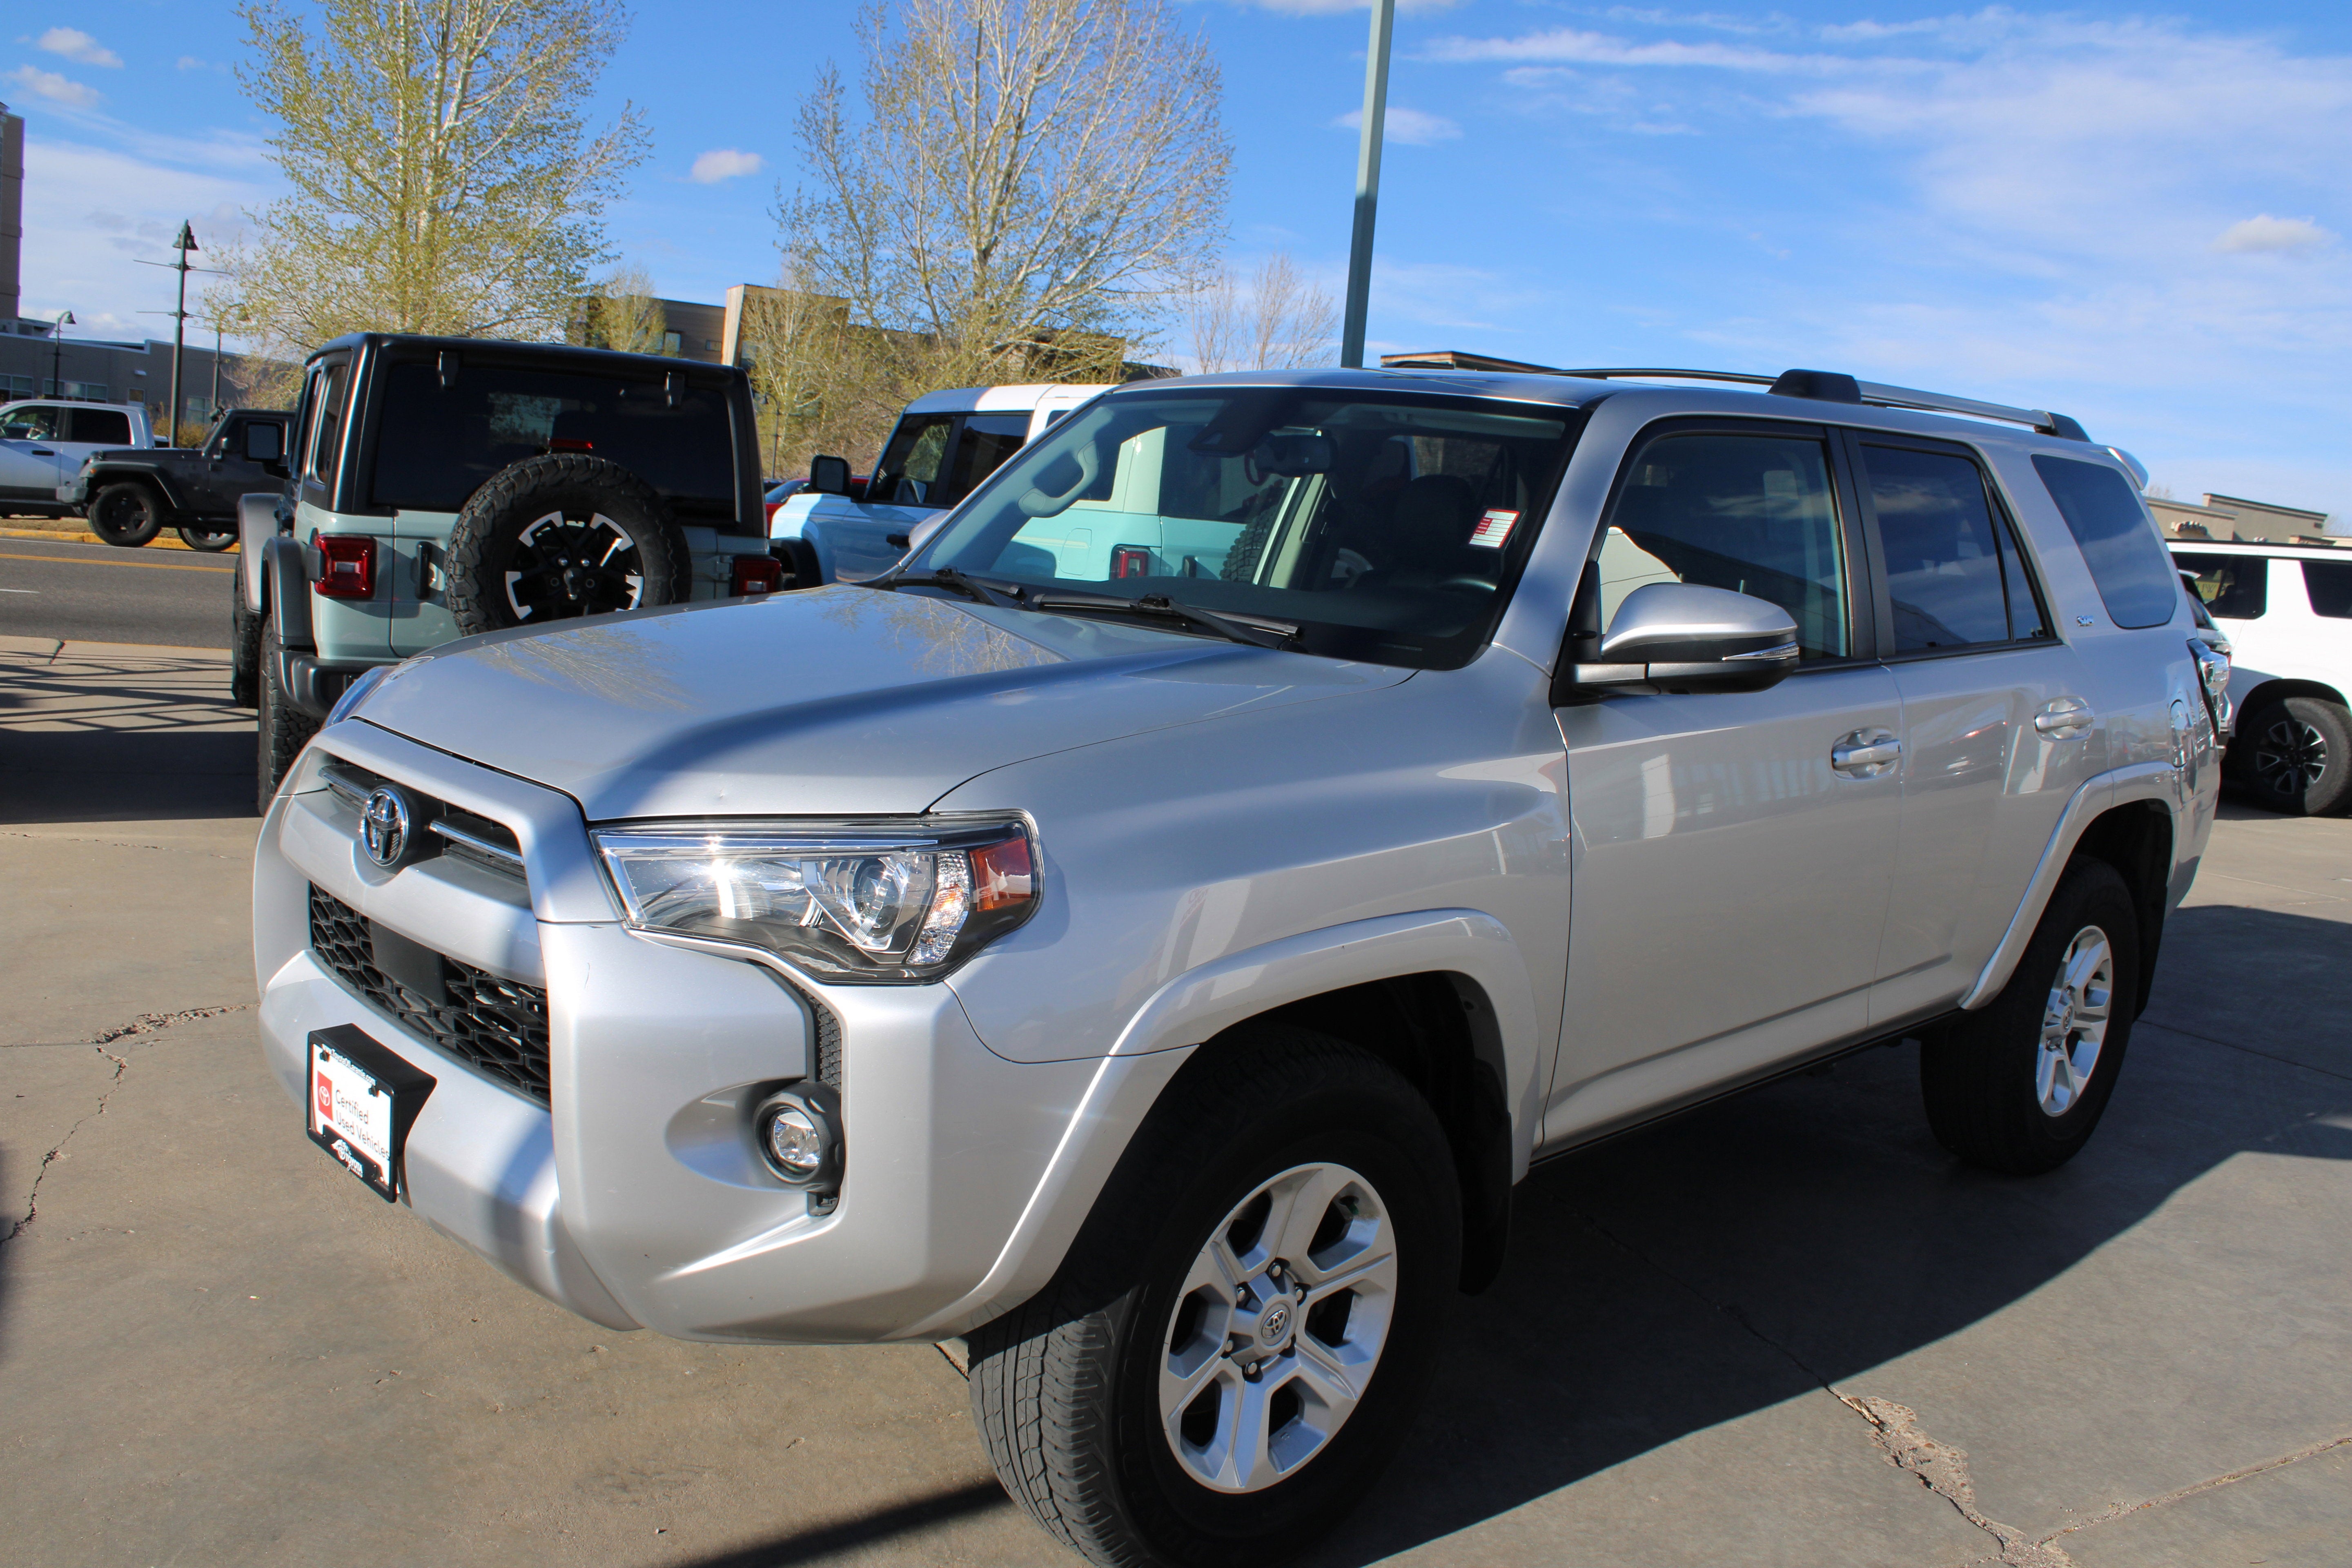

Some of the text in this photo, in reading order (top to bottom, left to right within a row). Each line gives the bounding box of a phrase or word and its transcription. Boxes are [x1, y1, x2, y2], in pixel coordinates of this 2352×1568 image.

[336, 1089, 369, 1125] Certified
[336, 1109, 390, 1160] Used Vehicles
